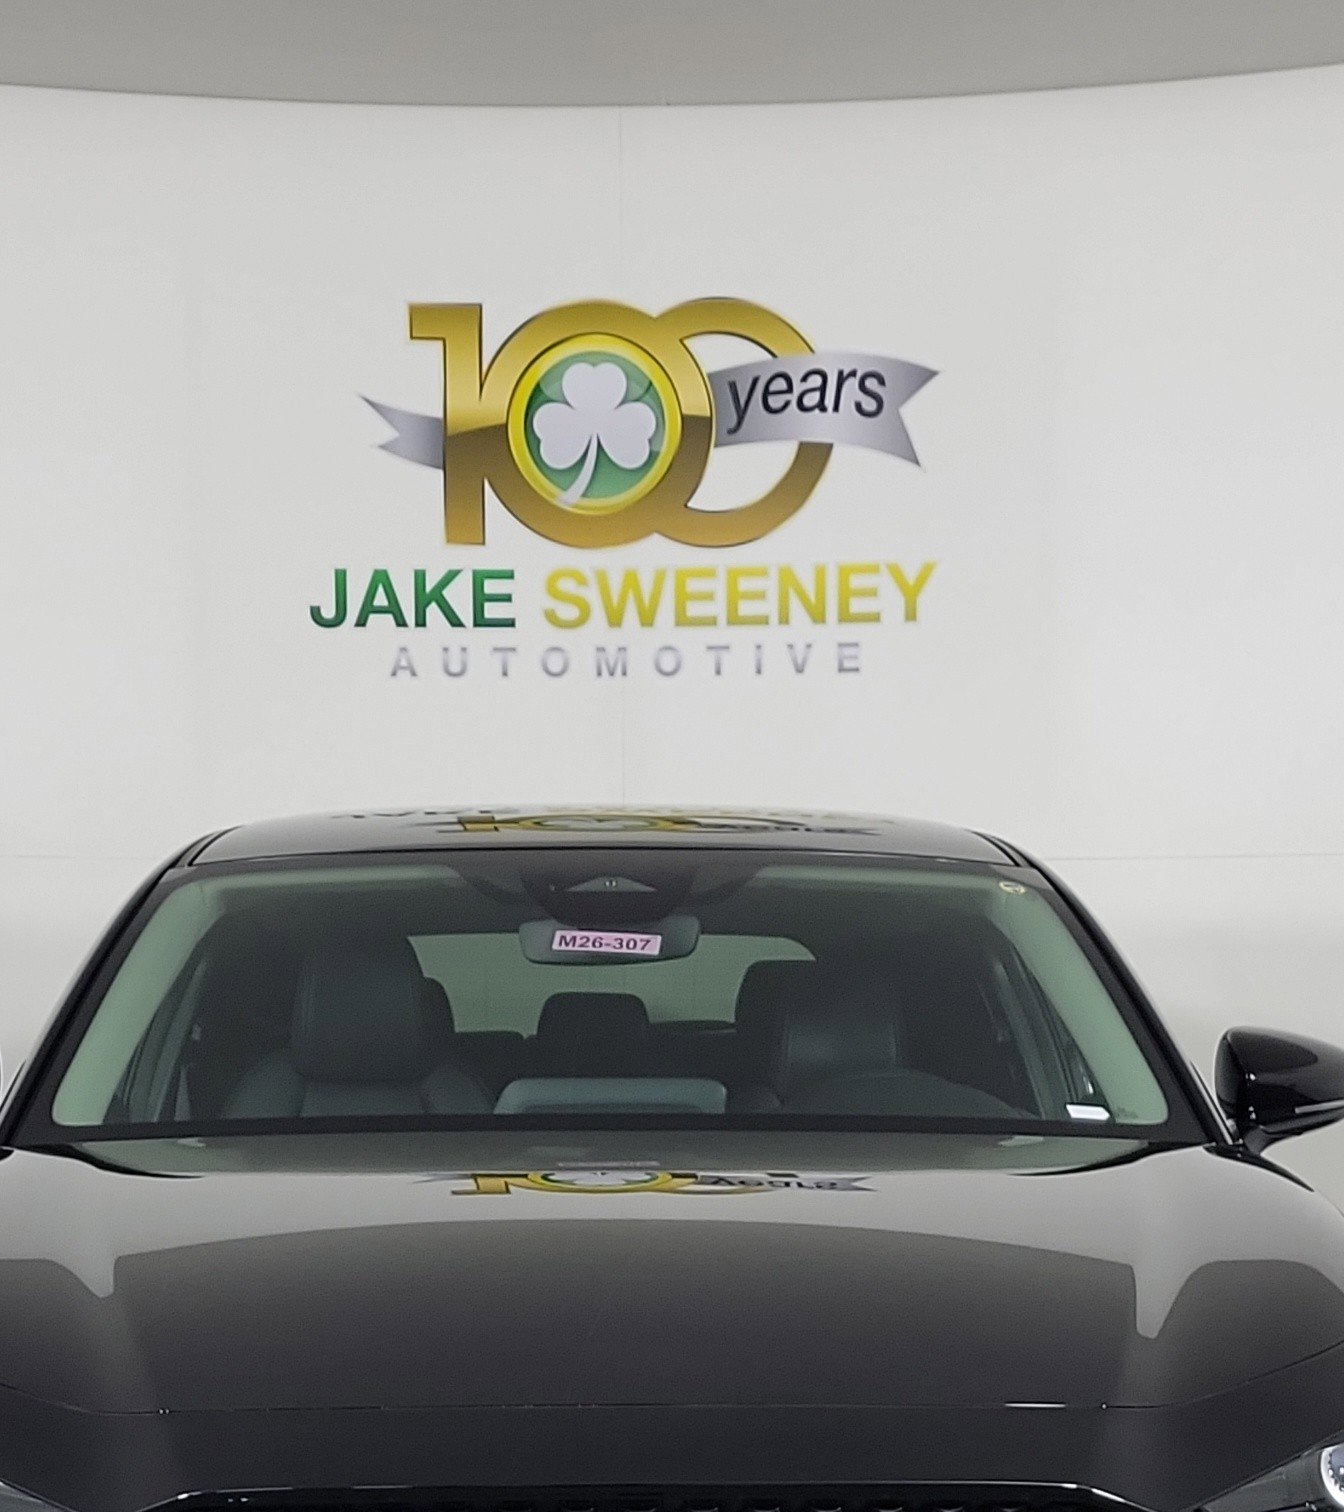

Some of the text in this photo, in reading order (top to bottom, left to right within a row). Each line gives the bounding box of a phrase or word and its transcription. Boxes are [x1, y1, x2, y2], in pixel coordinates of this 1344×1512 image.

[408, 297, 886, 549] 100 years
[309, 562, 937, 631] JAKE SWEENEY
[390, 643, 862, 679] AUTOMOTIVE
[558, 935, 652, 952] M26-307
